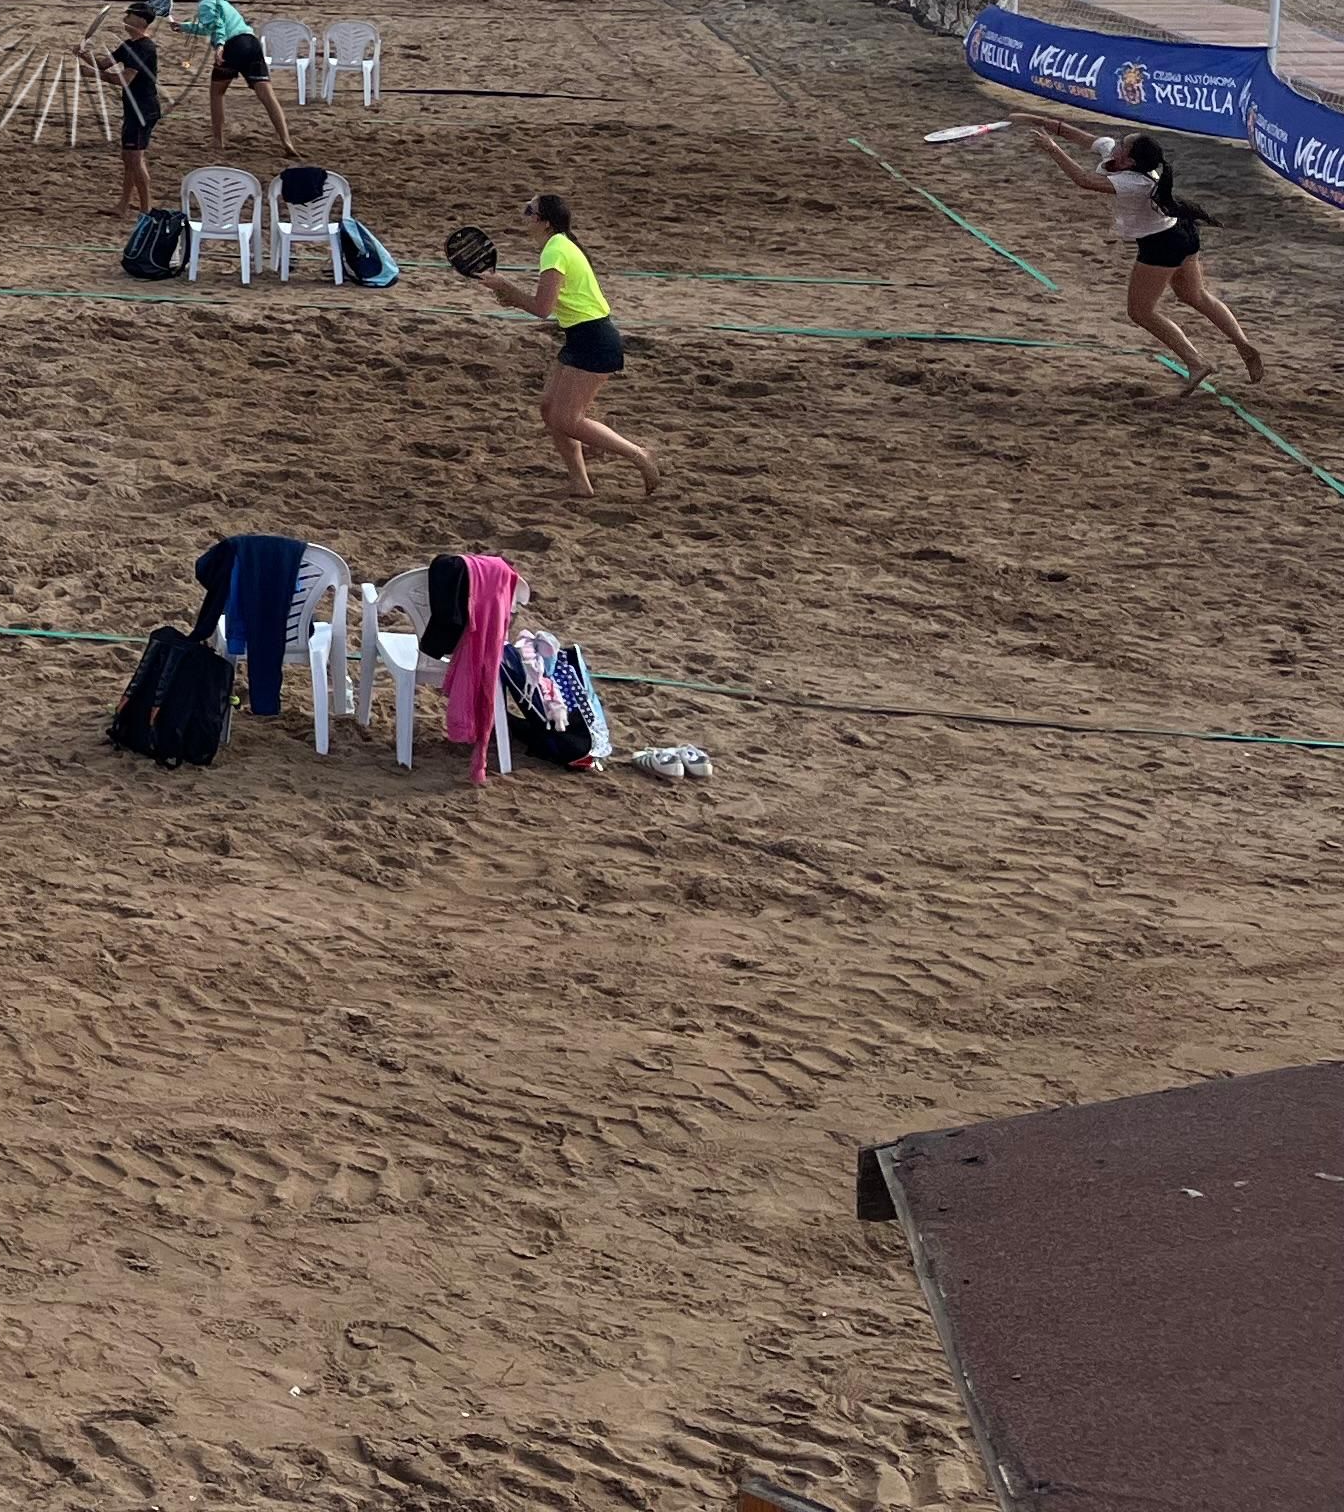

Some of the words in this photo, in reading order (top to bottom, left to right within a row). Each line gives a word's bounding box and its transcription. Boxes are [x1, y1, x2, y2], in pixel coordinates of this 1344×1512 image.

[980, 41, 1021, 74] MELILLA
[1029, 44, 1105, 87] MELILLA
[1153, 82, 1234, 115] MELILLA
[1255, 128, 1290, 173] MELILLA
